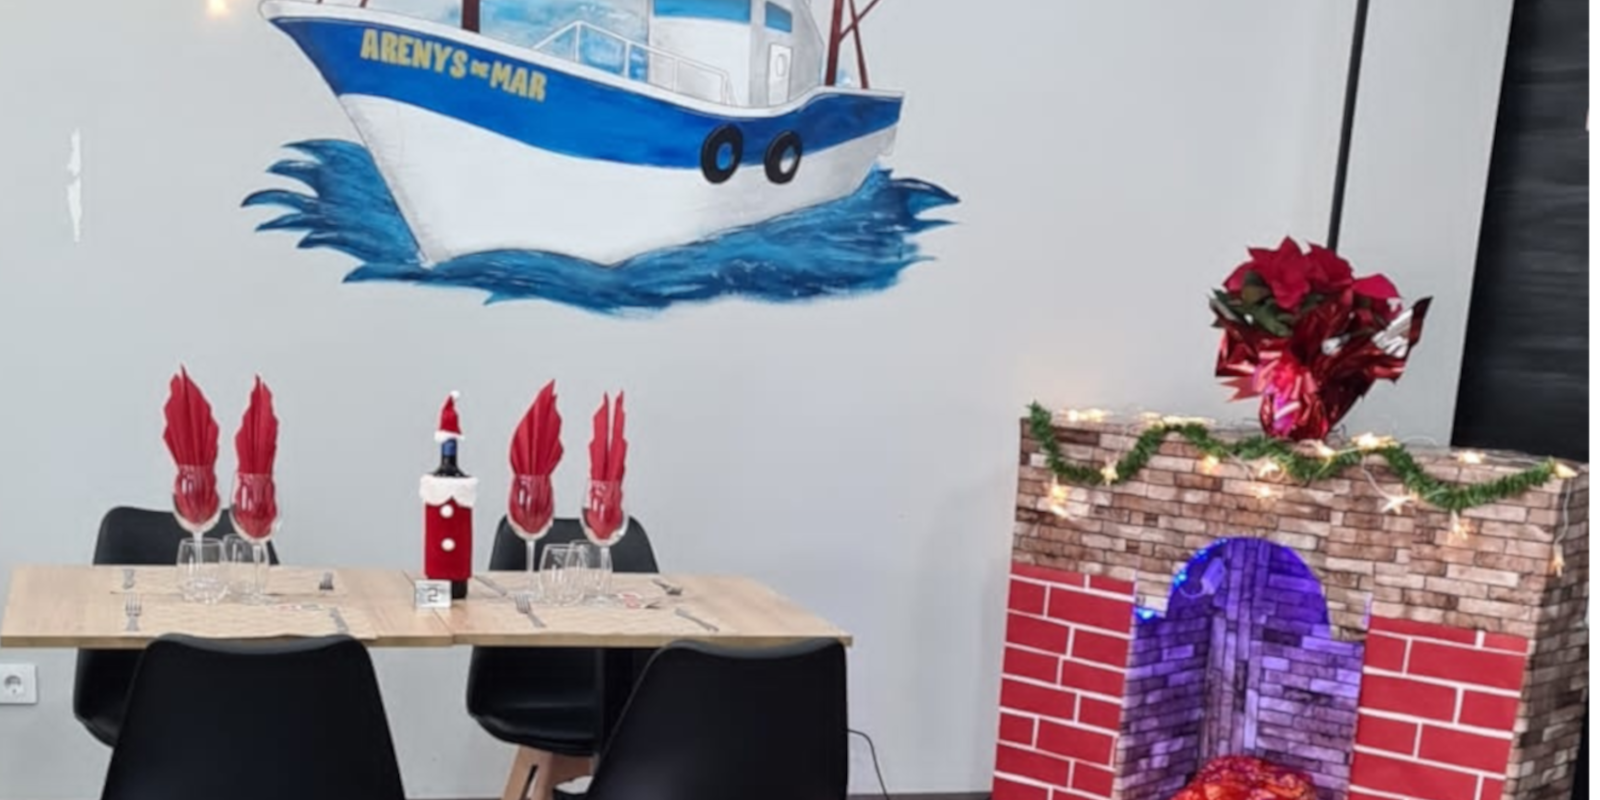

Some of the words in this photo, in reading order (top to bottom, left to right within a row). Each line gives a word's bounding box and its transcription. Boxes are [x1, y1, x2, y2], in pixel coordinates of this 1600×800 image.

[360, 28, 469, 79] ARENYS
[490, 61, 548, 102] MAR
[427, 587, 439, 603] 2
